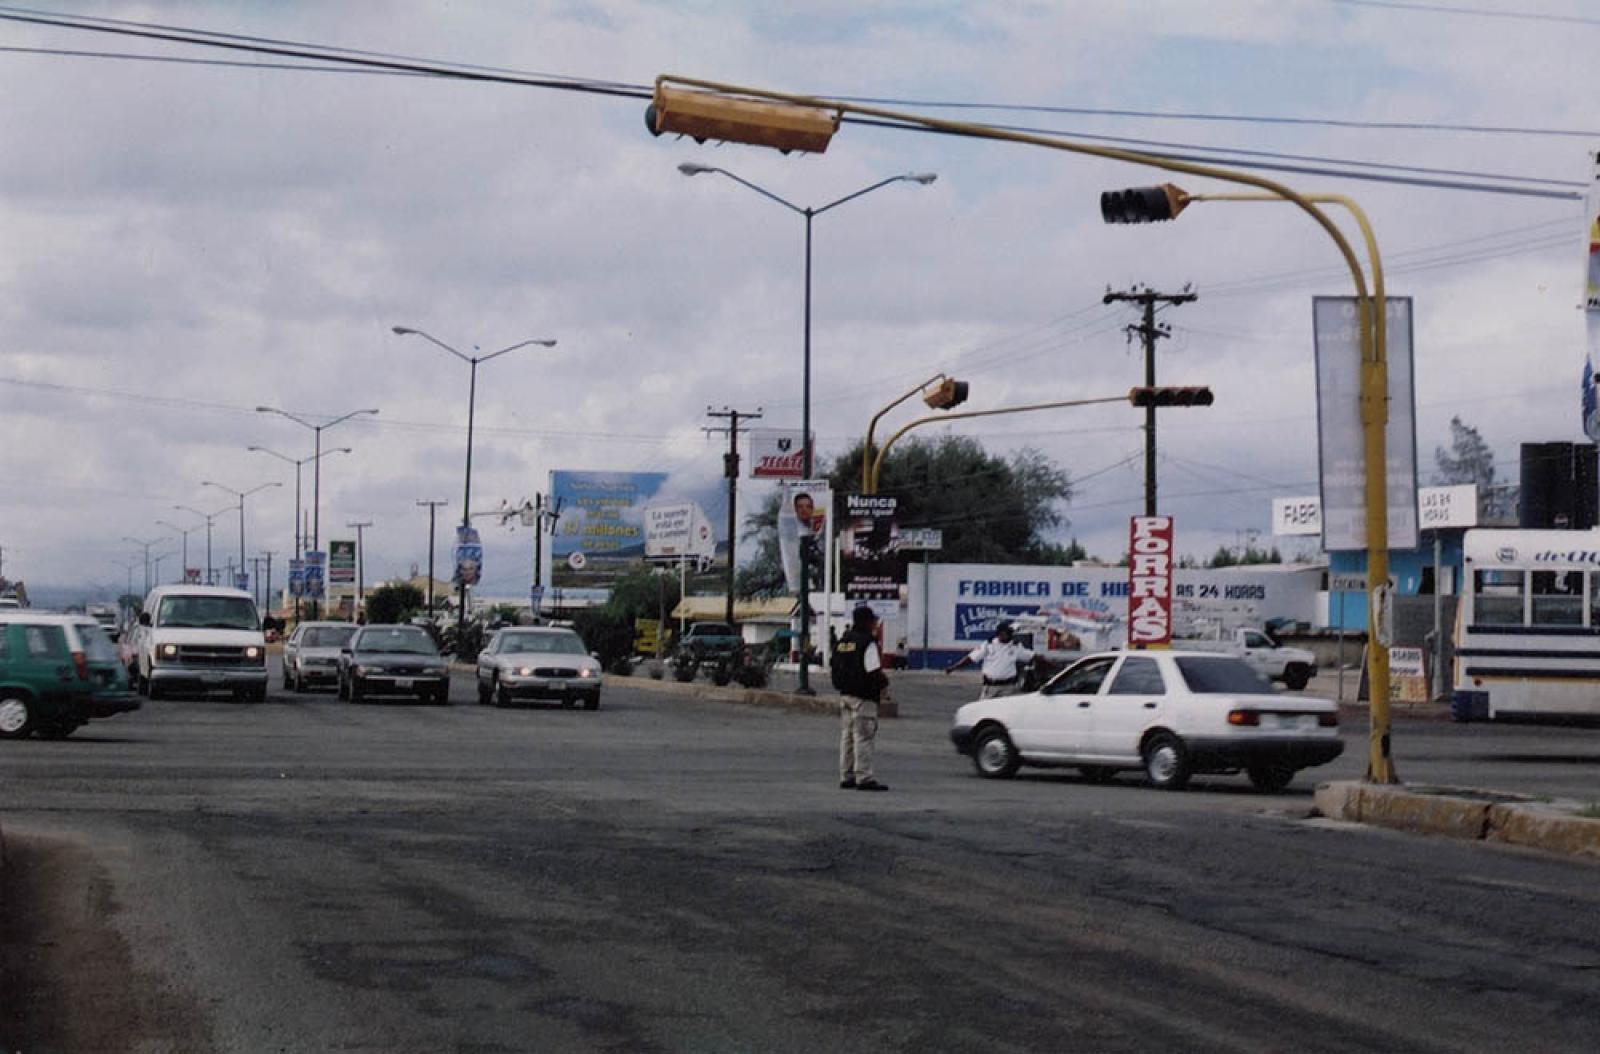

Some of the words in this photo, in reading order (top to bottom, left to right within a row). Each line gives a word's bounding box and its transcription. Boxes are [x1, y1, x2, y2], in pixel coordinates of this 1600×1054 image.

[847, 496, 897, 508] Nunca
[1284, 503, 1318, 524] FABR
[1132, 517, 1170, 641] PORRAS
[959, 580, 1050, 596] FABRICA
[1062, 581, 1089, 596] DE
[1101, 581, 1129, 596] HIE
[1175, 584, 1195, 598] AS
[1199, 584, 1219, 599] 24
[1224, 585, 1266, 599] HORAS
